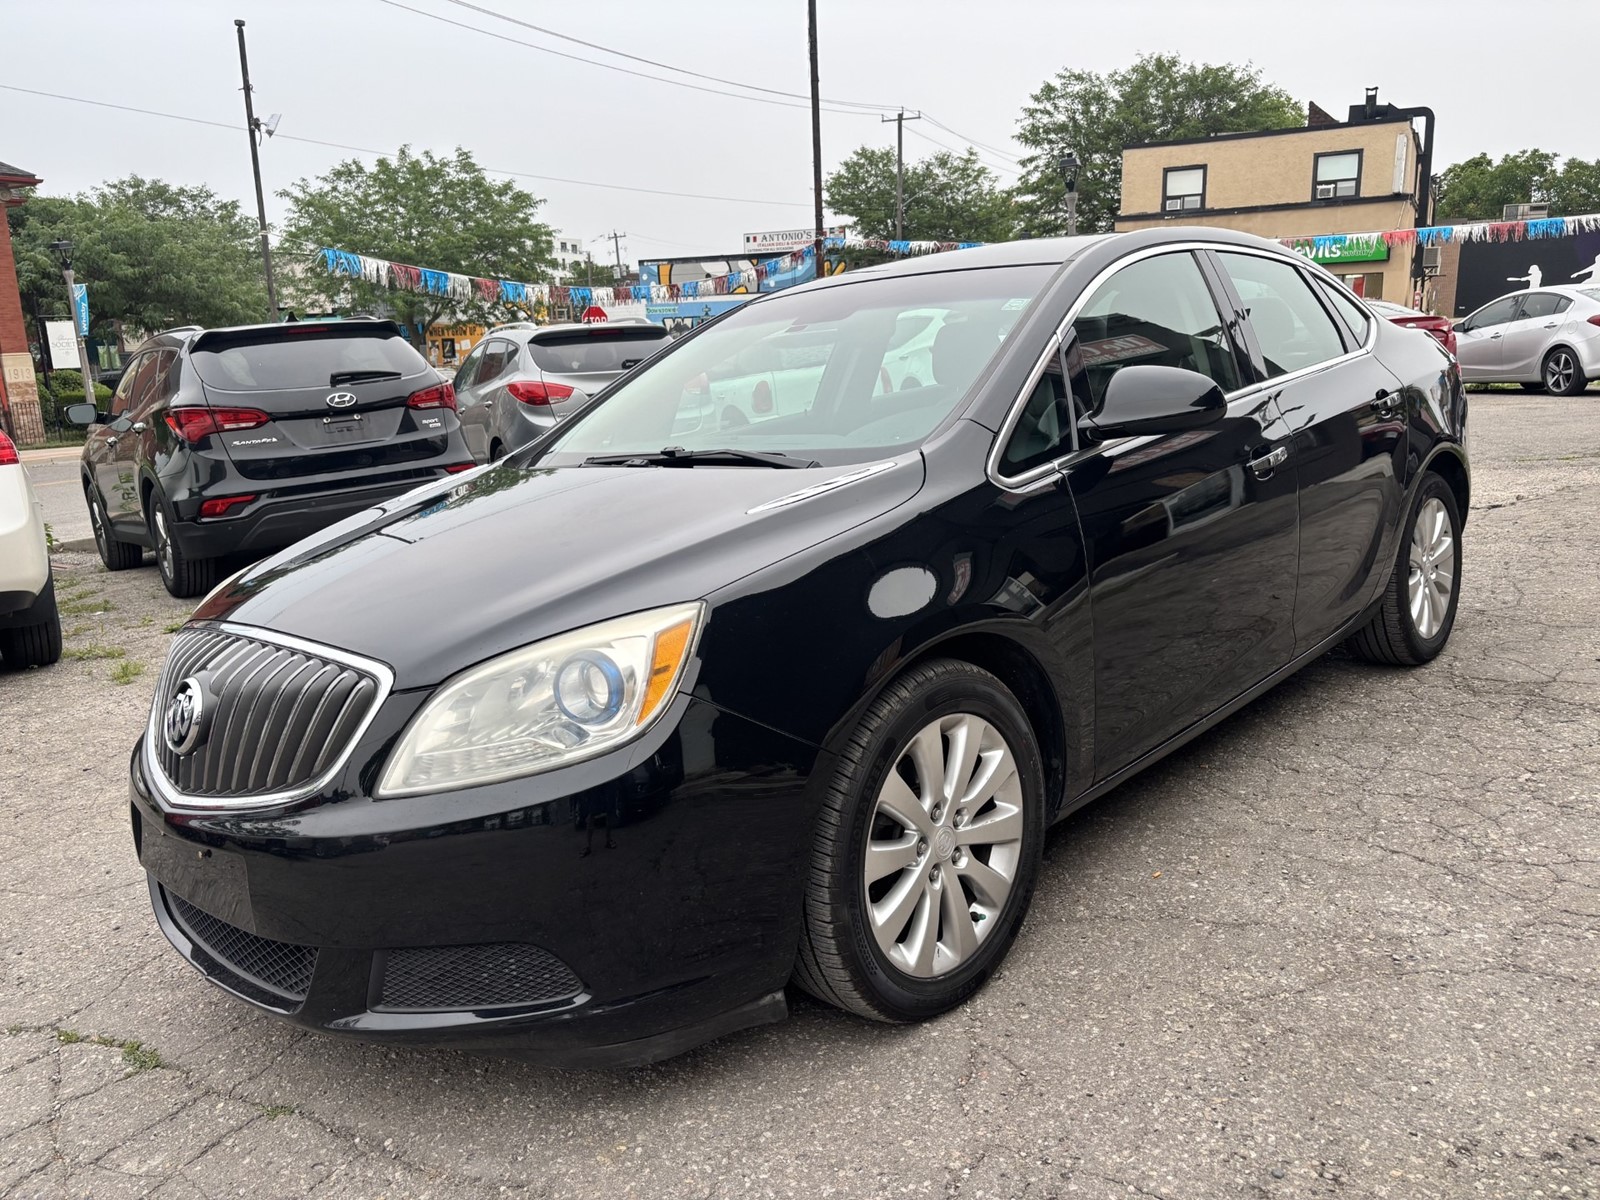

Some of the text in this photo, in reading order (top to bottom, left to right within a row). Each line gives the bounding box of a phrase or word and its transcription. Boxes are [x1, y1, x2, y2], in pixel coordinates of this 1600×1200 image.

[761, 230, 813, 243] ANTONIO'S
[584, 316, 607, 324] STOP
[8, 368, 32, 379] 1913
